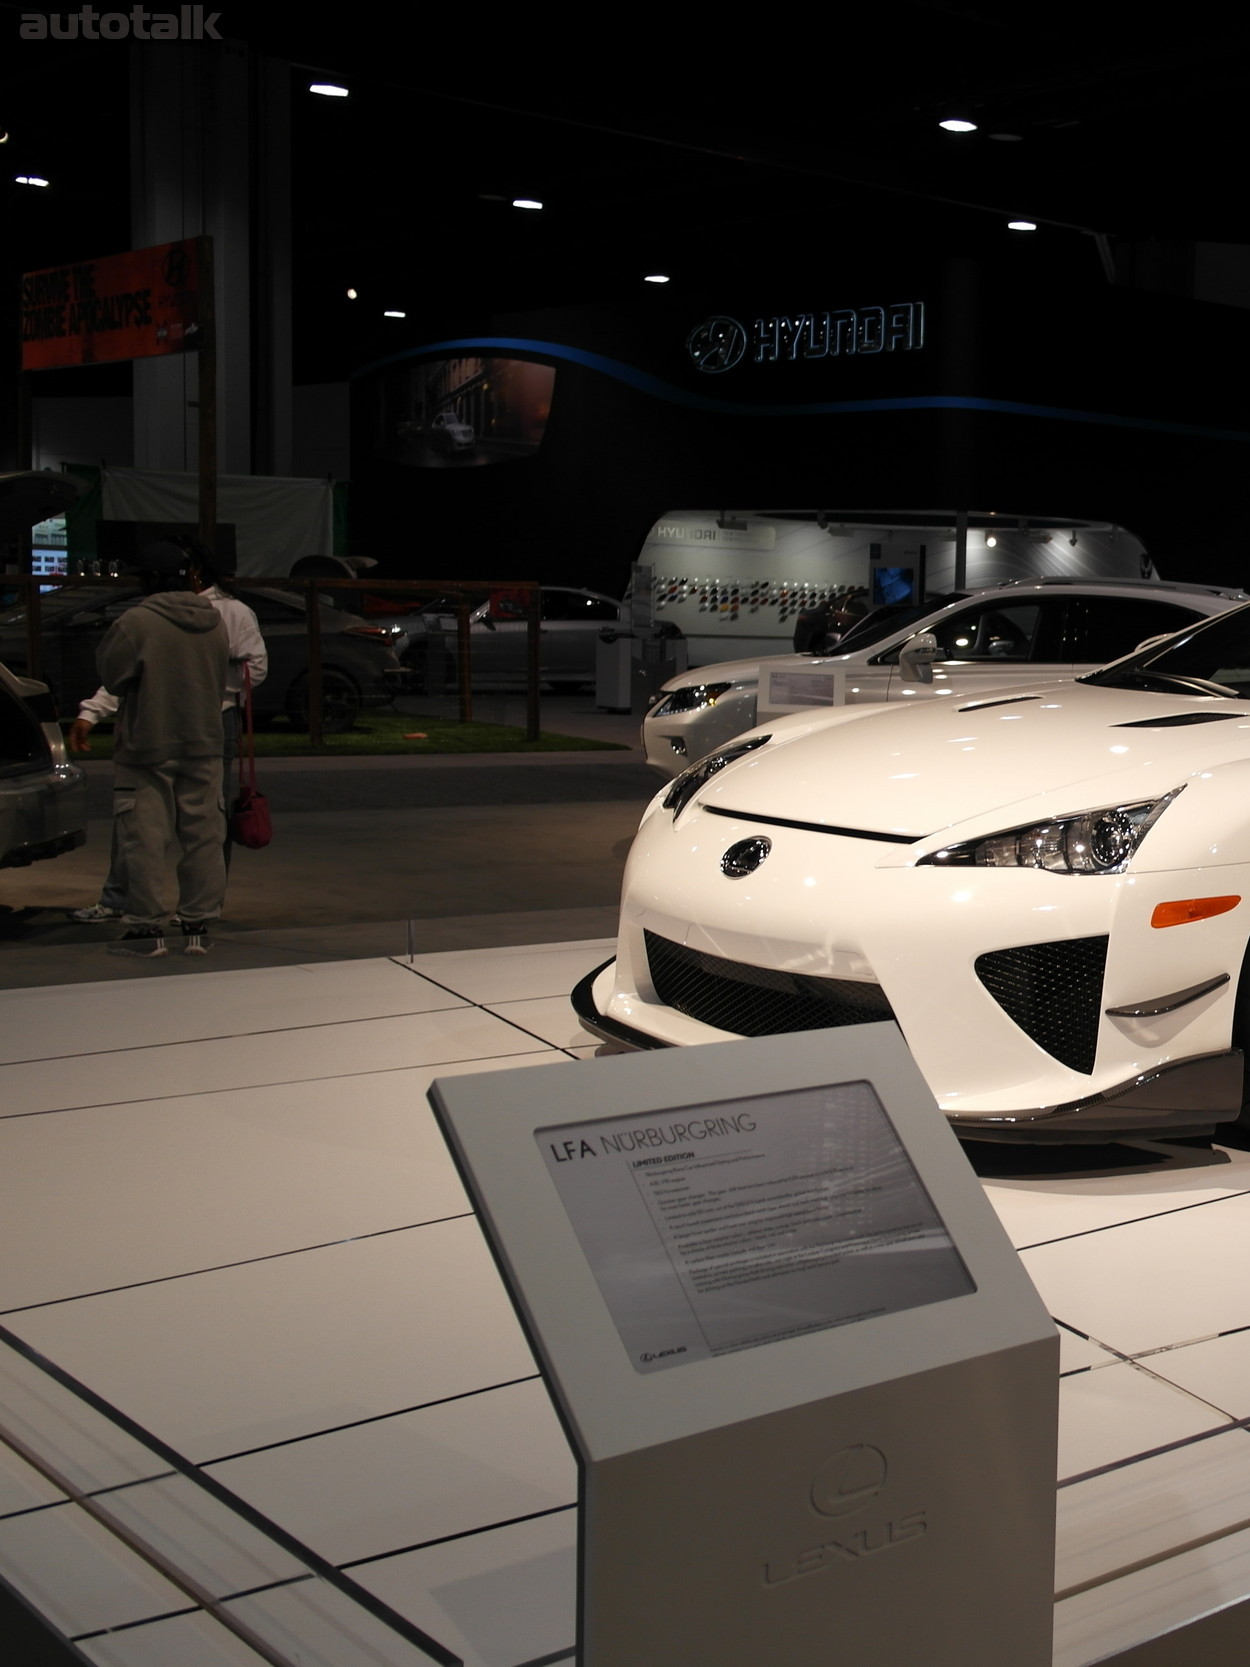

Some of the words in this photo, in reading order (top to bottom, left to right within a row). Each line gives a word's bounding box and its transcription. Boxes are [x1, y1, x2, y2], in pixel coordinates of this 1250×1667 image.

[68, 288, 152, 336] APOCALYPSE
[754, 302, 924, 363] HYUNDAI
[550, 1139, 597, 1162] LFA
[600, 1113, 757, 1155] NÜRBURGRING
[632, 1156, 663, 1168] LIMITED
[664, 1151, 695, 1164] EDITION
[761, 1510, 929, 1587] LEXUS
